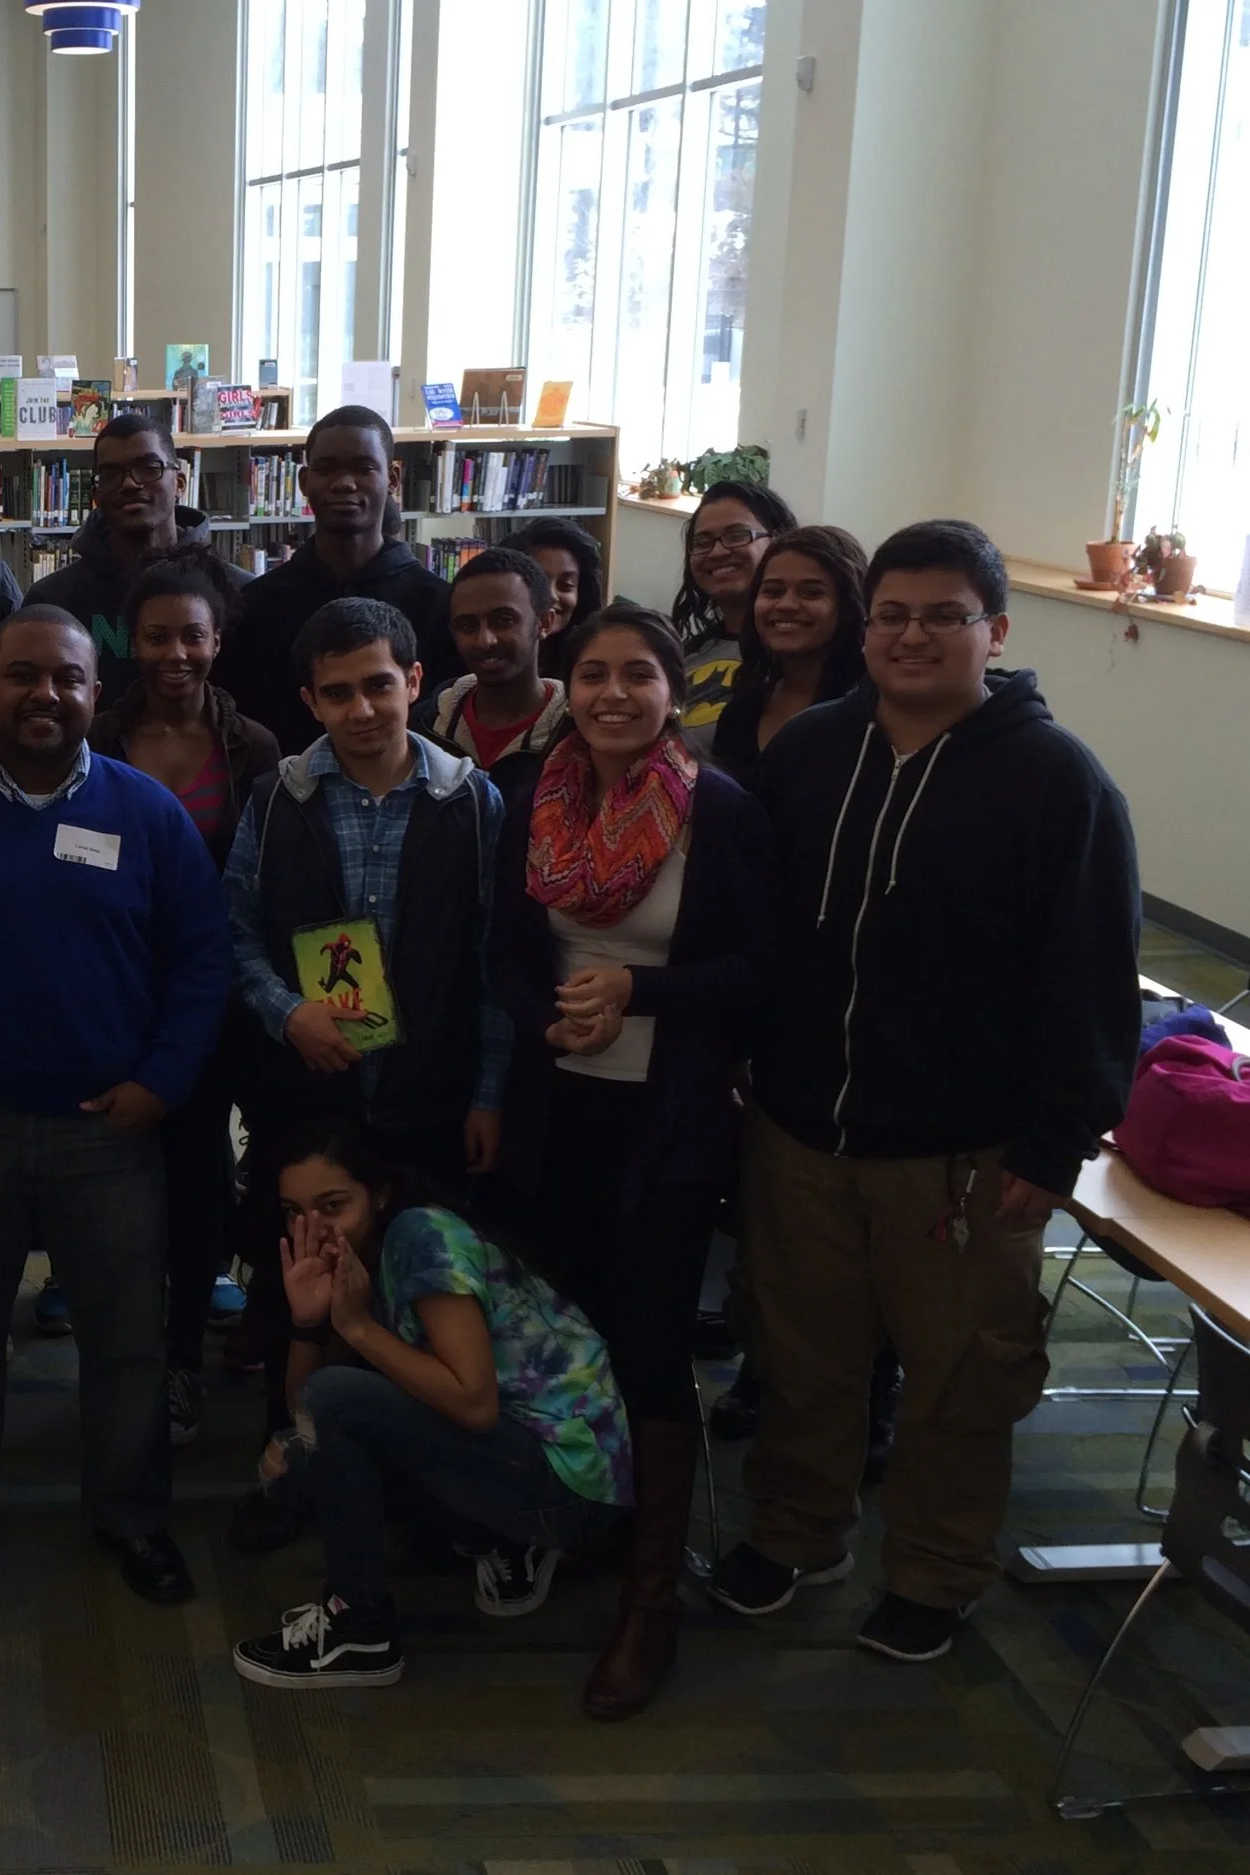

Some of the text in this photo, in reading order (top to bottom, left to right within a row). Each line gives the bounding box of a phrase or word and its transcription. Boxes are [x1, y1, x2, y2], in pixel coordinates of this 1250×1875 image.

[26, 396, 50, 405] JOIN THE
[218, 389, 254, 404] GIRLS
[19, 406, 57, 424] CLUB
